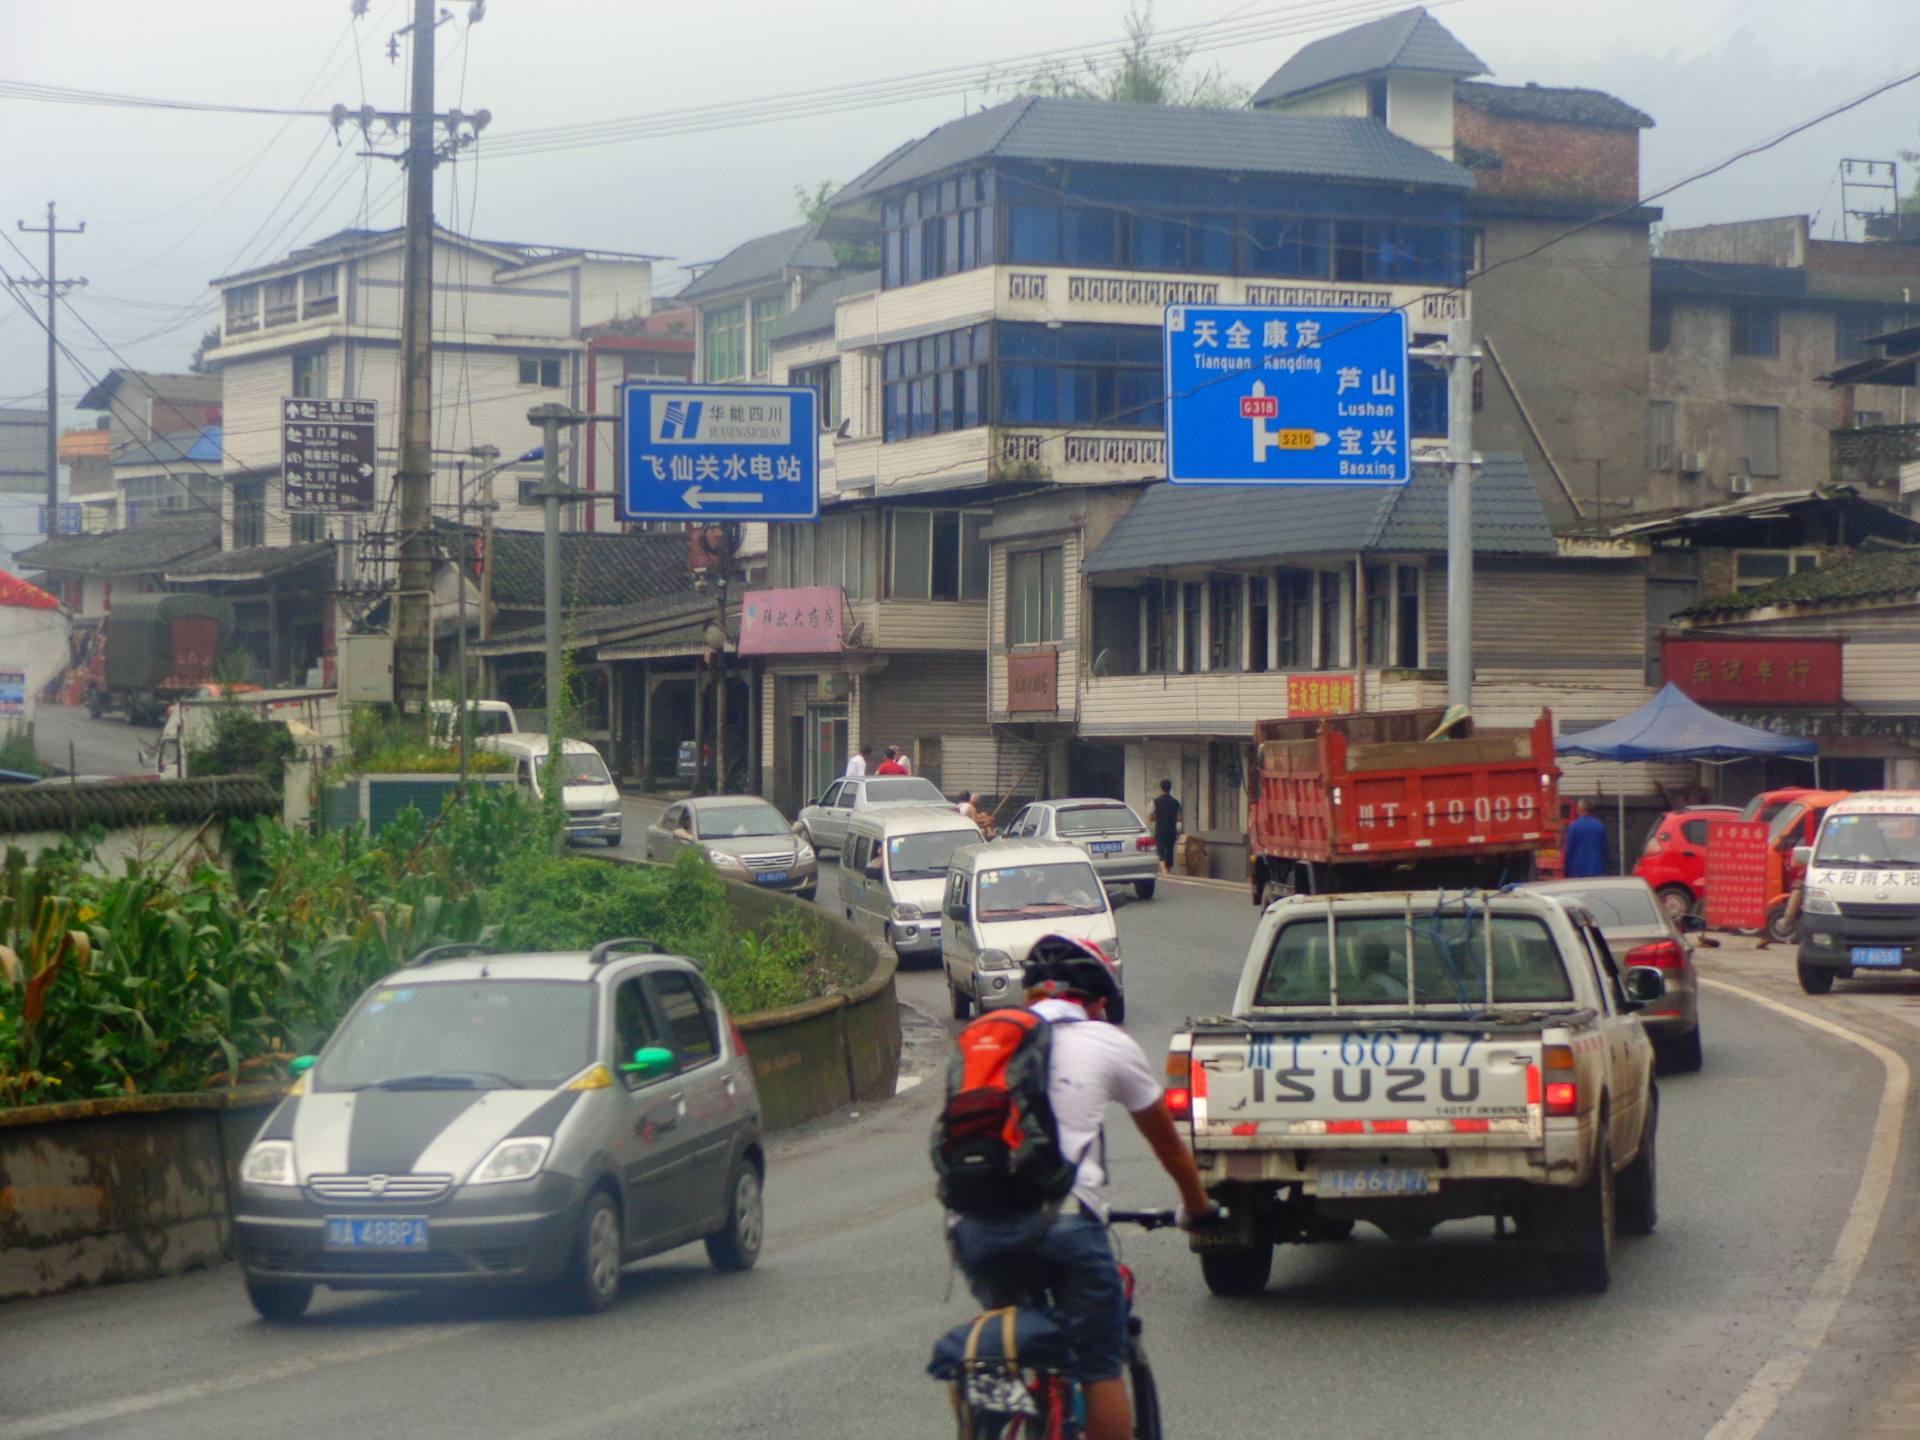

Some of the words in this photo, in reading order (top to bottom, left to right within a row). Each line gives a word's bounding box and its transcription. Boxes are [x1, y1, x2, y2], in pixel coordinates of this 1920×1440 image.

[1193, 320, 1251, 349] 天全
[1262, 320, 1321, 349] 康定
[1195, 353, 1251, 371] Tianquan
[1264, 356, 1321, 374] Kangding
[1337, 367, 1396, 396] 芦山
[709, 405, 783, 423] 华能四川
[1244, 402, 1274, 414] G318
[1338, 402, 1394, 417] Lushan
[1282, 436, 1312, 446] S210
[1337, 428, 1397, 456] 宝兴
[641, 453, 801, 482] 飞仙关水电站
[1339, 460, 1395, 479] Baoxing
[1253, 1068, 1479, 1103] ISUZU
